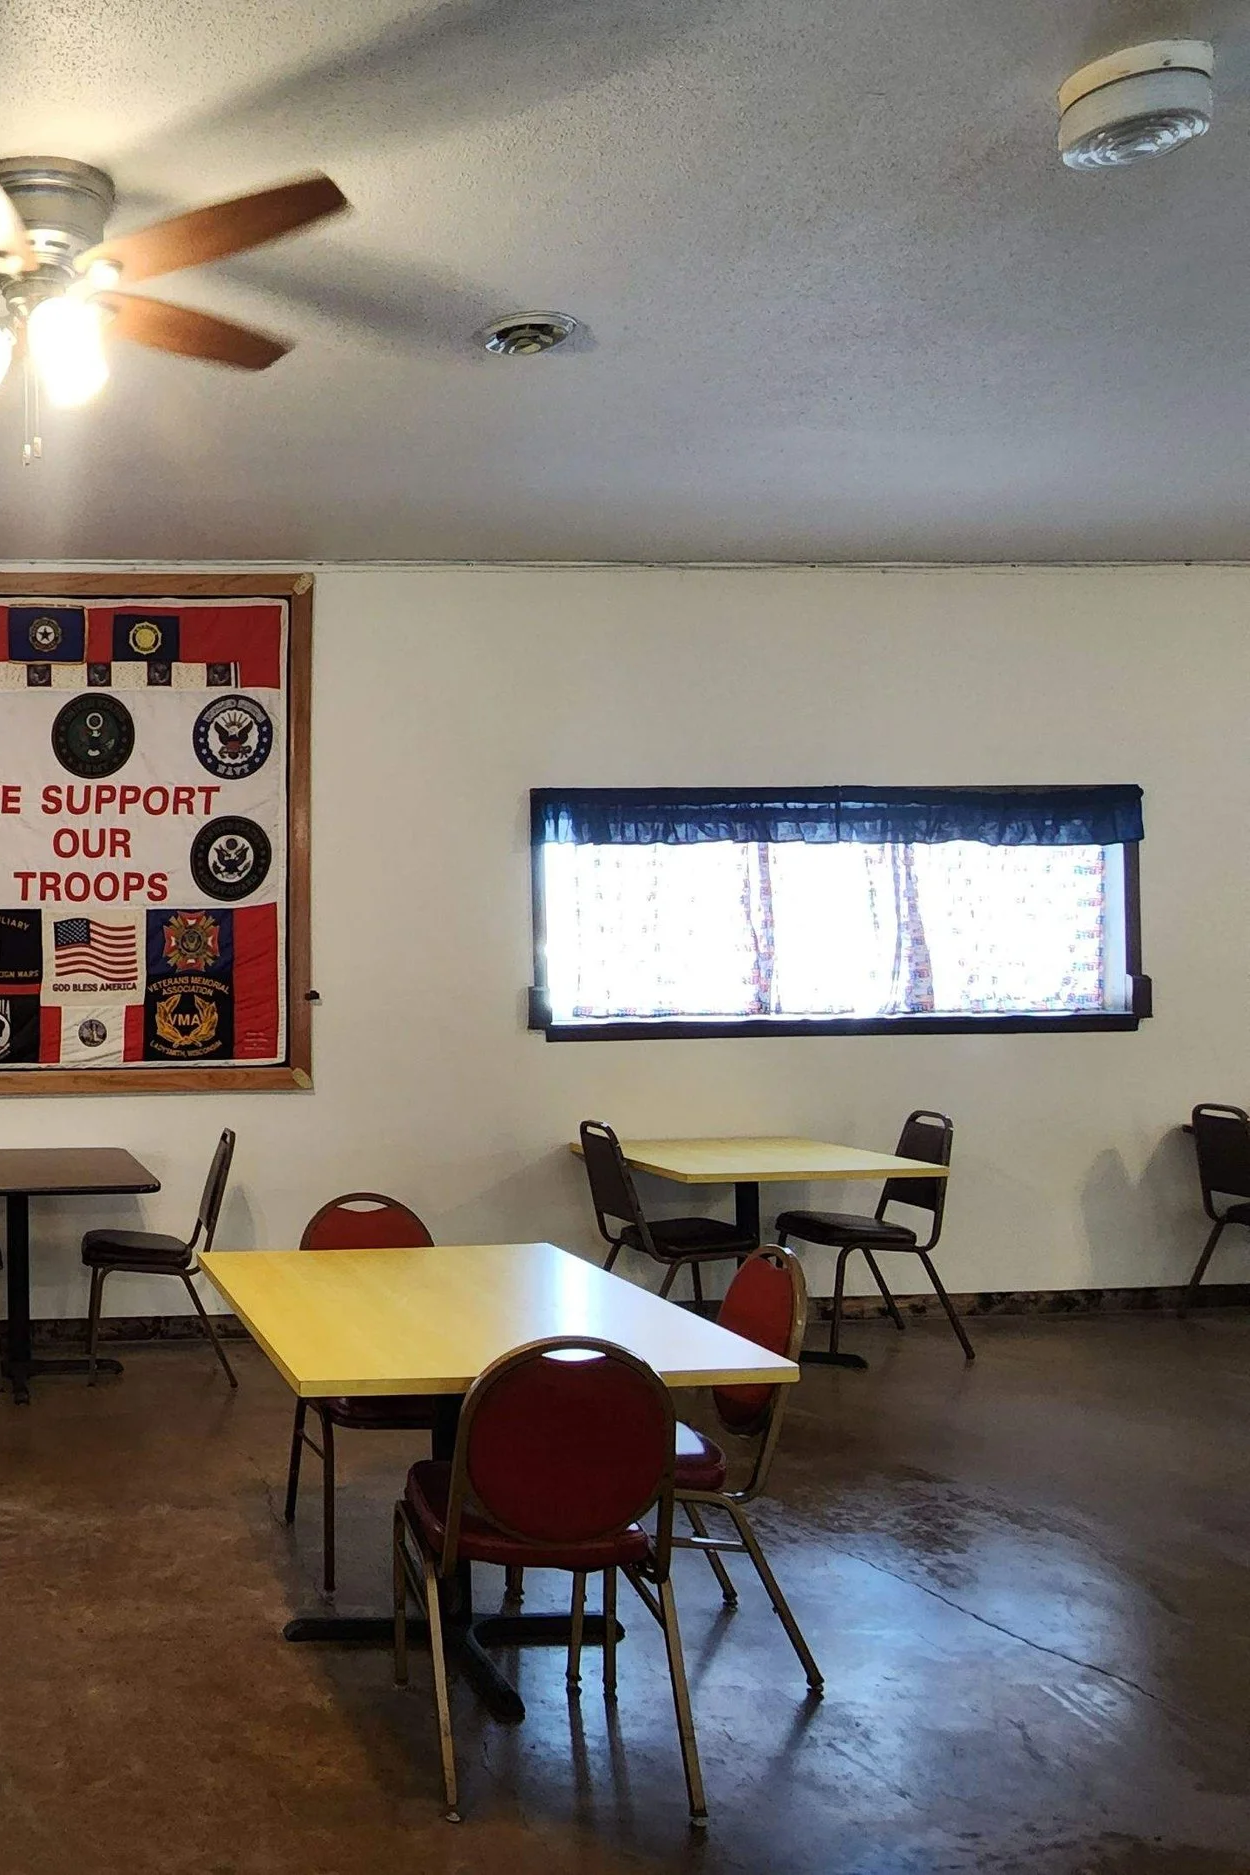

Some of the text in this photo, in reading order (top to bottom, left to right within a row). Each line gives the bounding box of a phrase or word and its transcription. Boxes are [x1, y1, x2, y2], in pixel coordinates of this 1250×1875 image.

[41, 785, 222, 816] SUPPORT
[53, 828, 131, 858] OUR
[13, 871, 169, 902] TROOPS
[17, 969, 40, 978] WARS
[52, 982, 138, 992] GOD BLESS AMERICA
[147, 976, 230, 994] VETERANS MEMORIAL
[162, 985, 213, 996] ASSOCIATION
[168, 1013, 202, 1026] VMA
